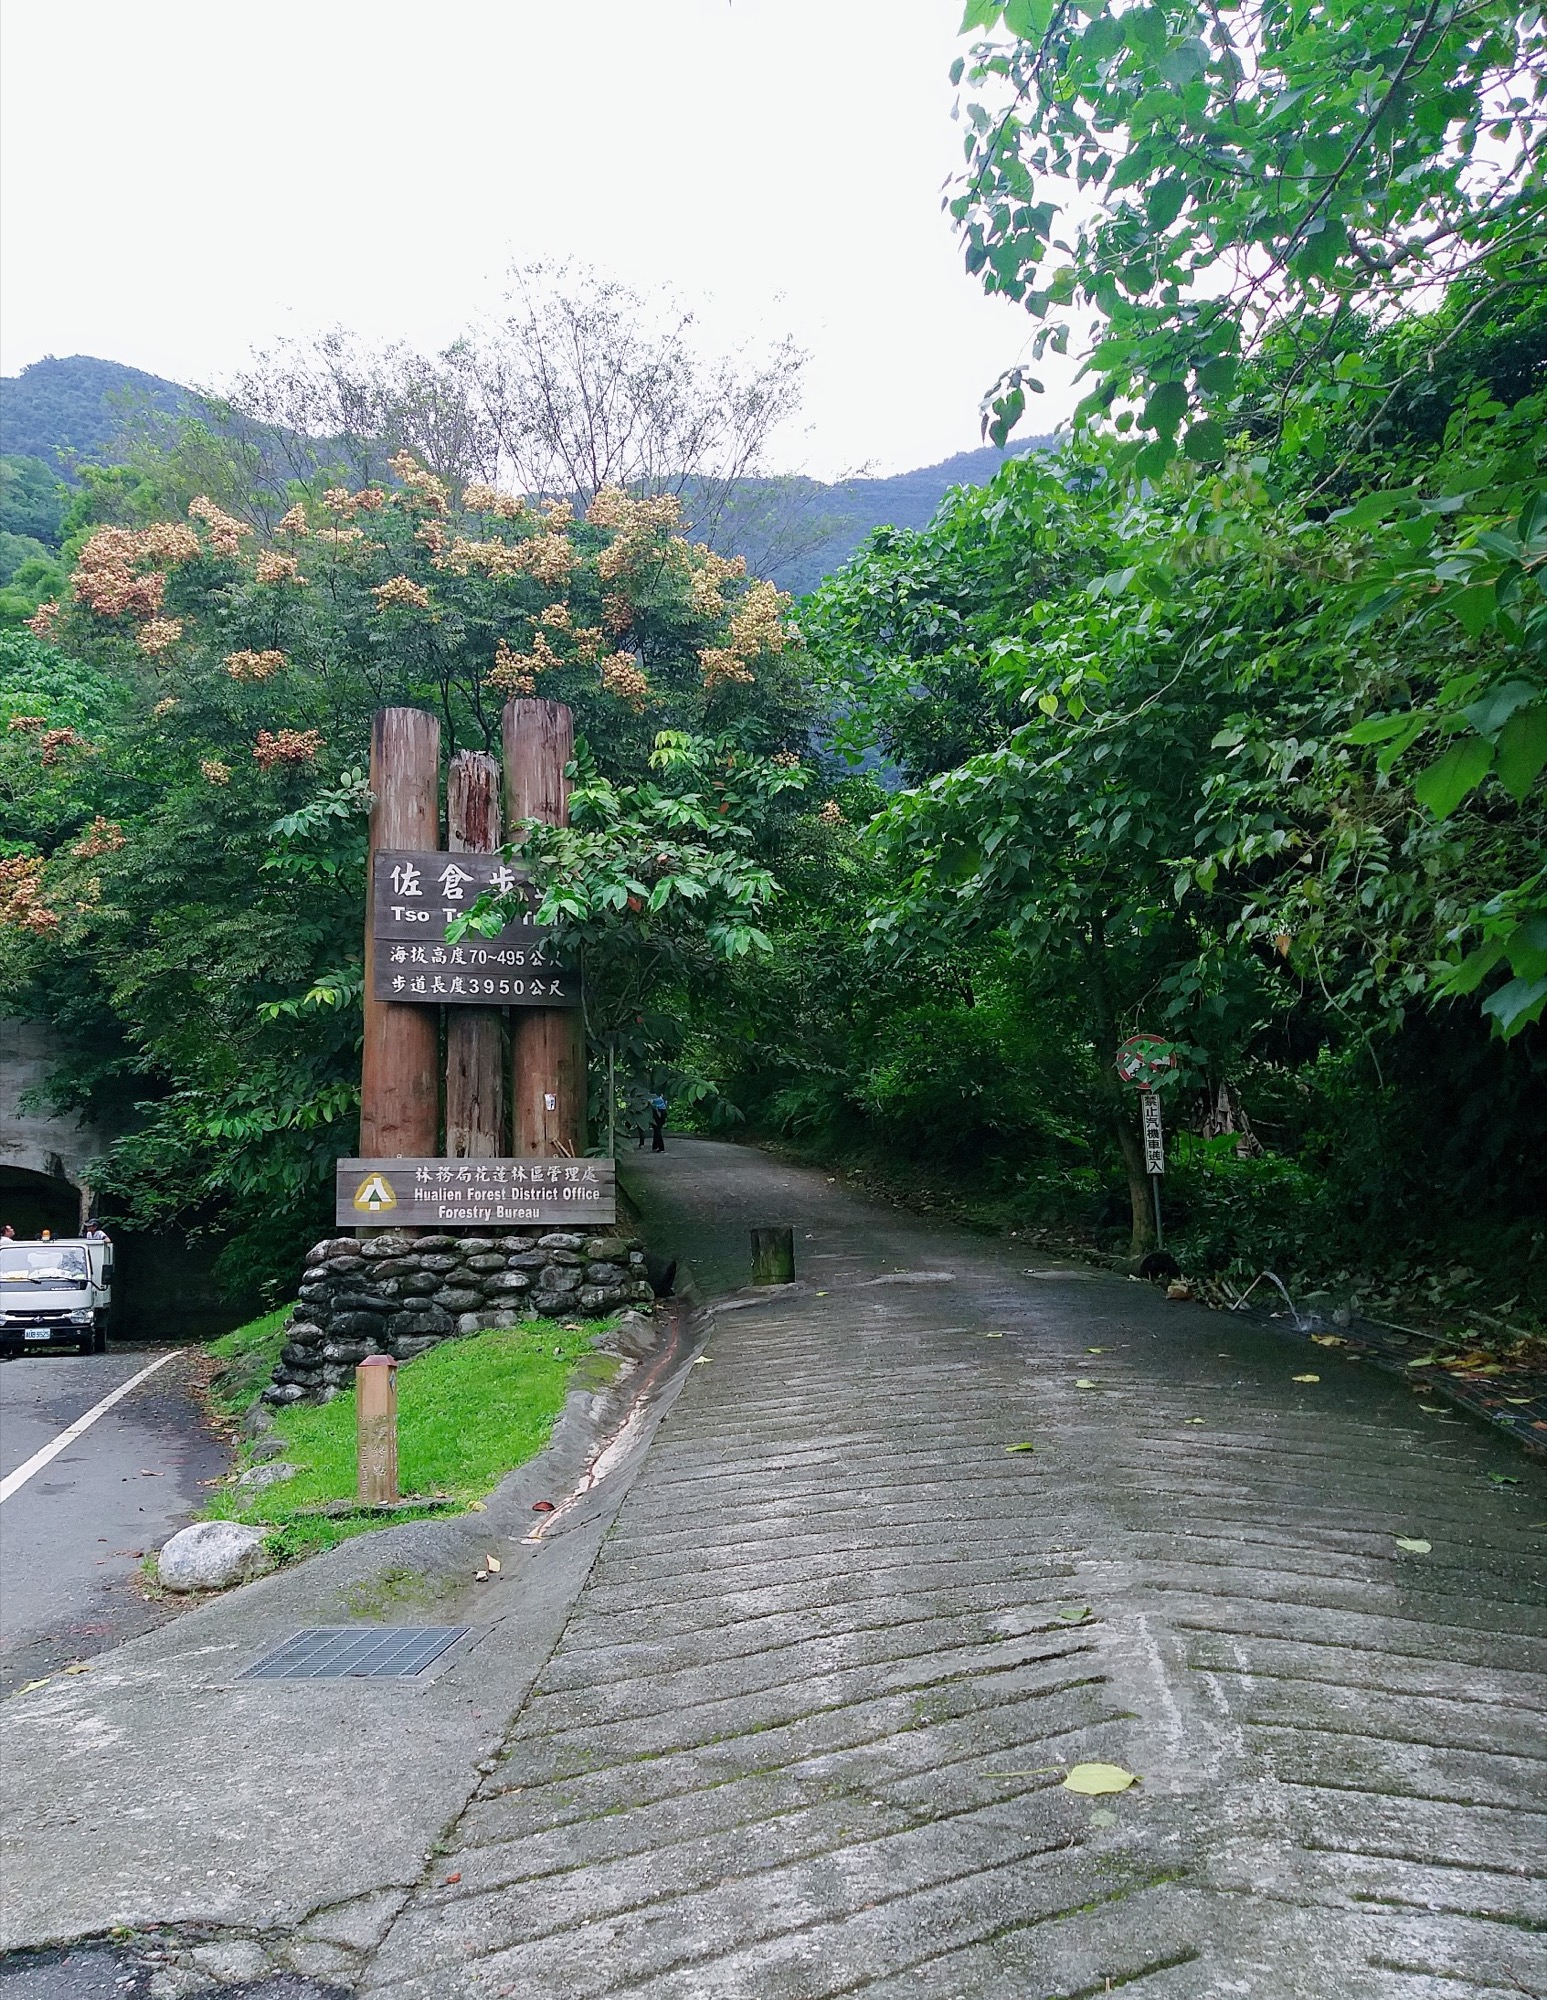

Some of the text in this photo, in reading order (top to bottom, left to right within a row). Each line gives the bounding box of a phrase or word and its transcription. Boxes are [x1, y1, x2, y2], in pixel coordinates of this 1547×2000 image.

[389, 861, 546, 900] 佐倉步
[391, 906, 430, 923] Tso
[391, 974, 566, 998] 步道長度3950公尺
[1144, 1096, 1162, 1172] 禁止汽機車進入
[415, 1165, 600, 1184] 林務局花蓮林區管理處
[414, 1187, 600, 1202] Hualien Forest District Office
[438, 1206, 540, 1222] Forestry Bureau
